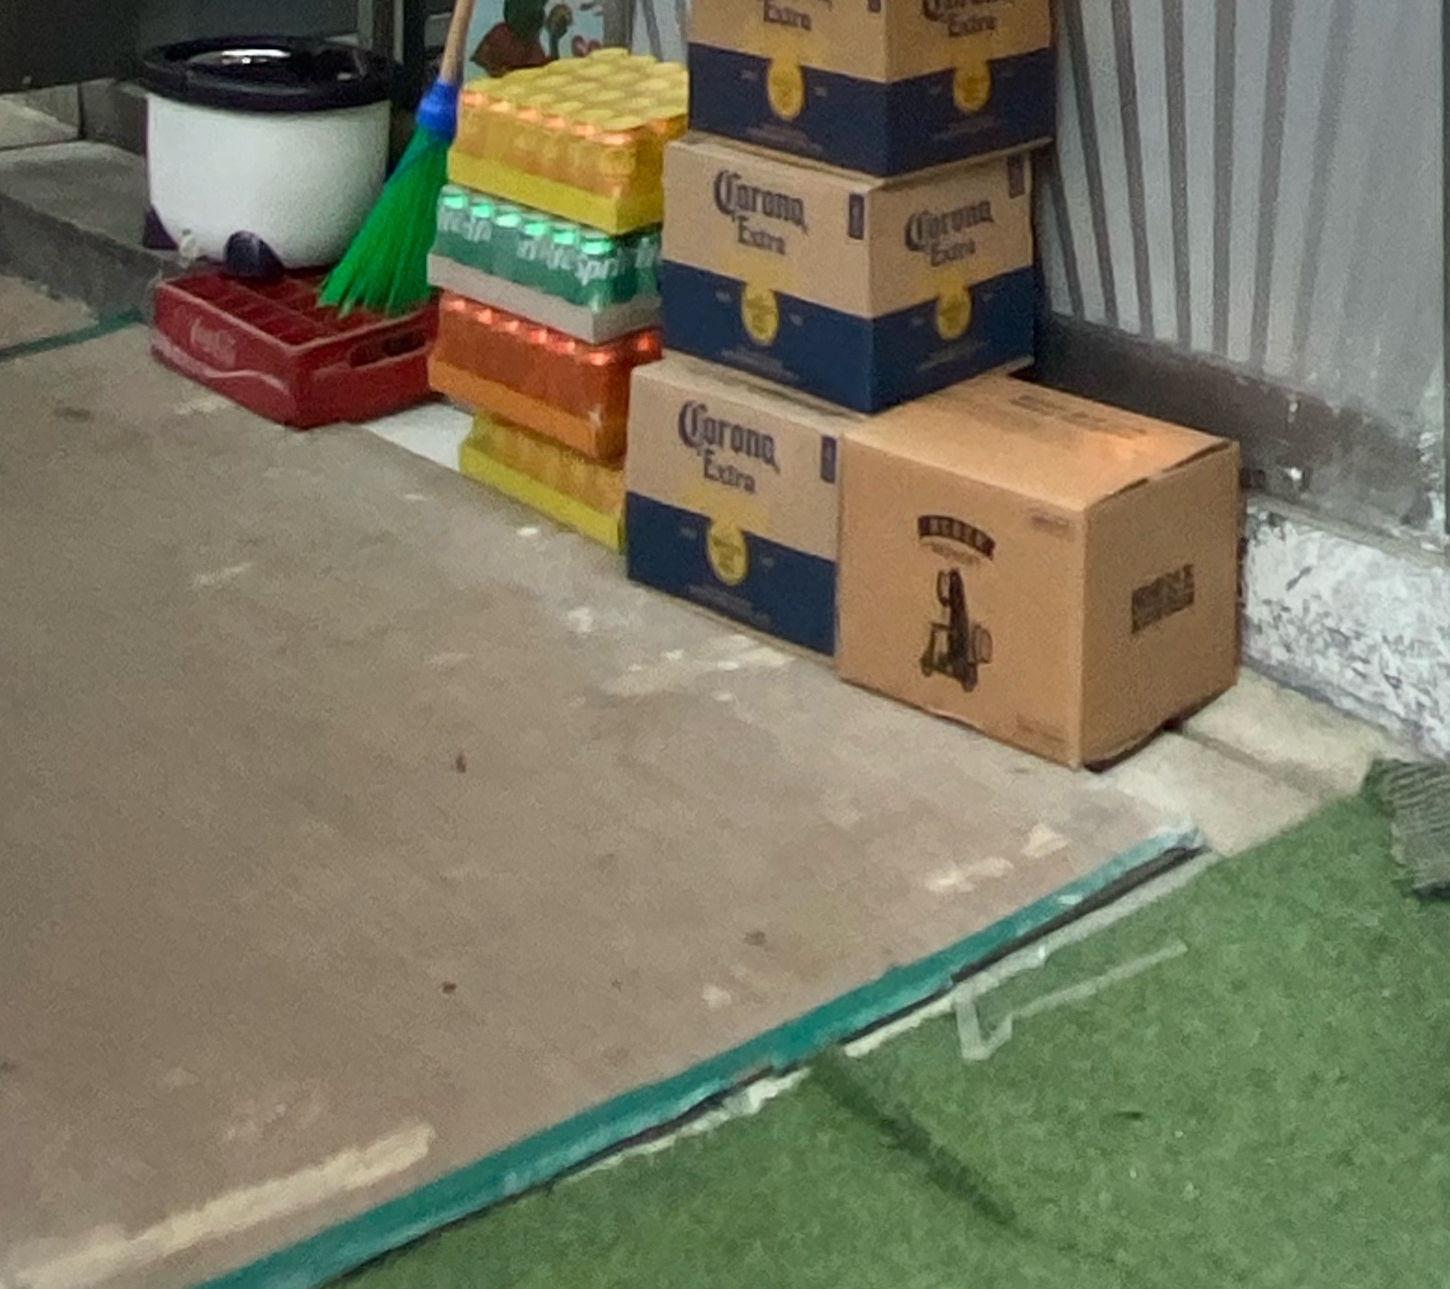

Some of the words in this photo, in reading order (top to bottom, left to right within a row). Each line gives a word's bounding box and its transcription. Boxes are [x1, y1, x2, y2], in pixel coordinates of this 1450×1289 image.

[713, 169, 808, 237] Corona
[904, 199, 996, 252] Corona
[737, 215, 786, 256] Extra
[678, 399, 781, 474] Corona
[702, 448, 756, 494] Extra
